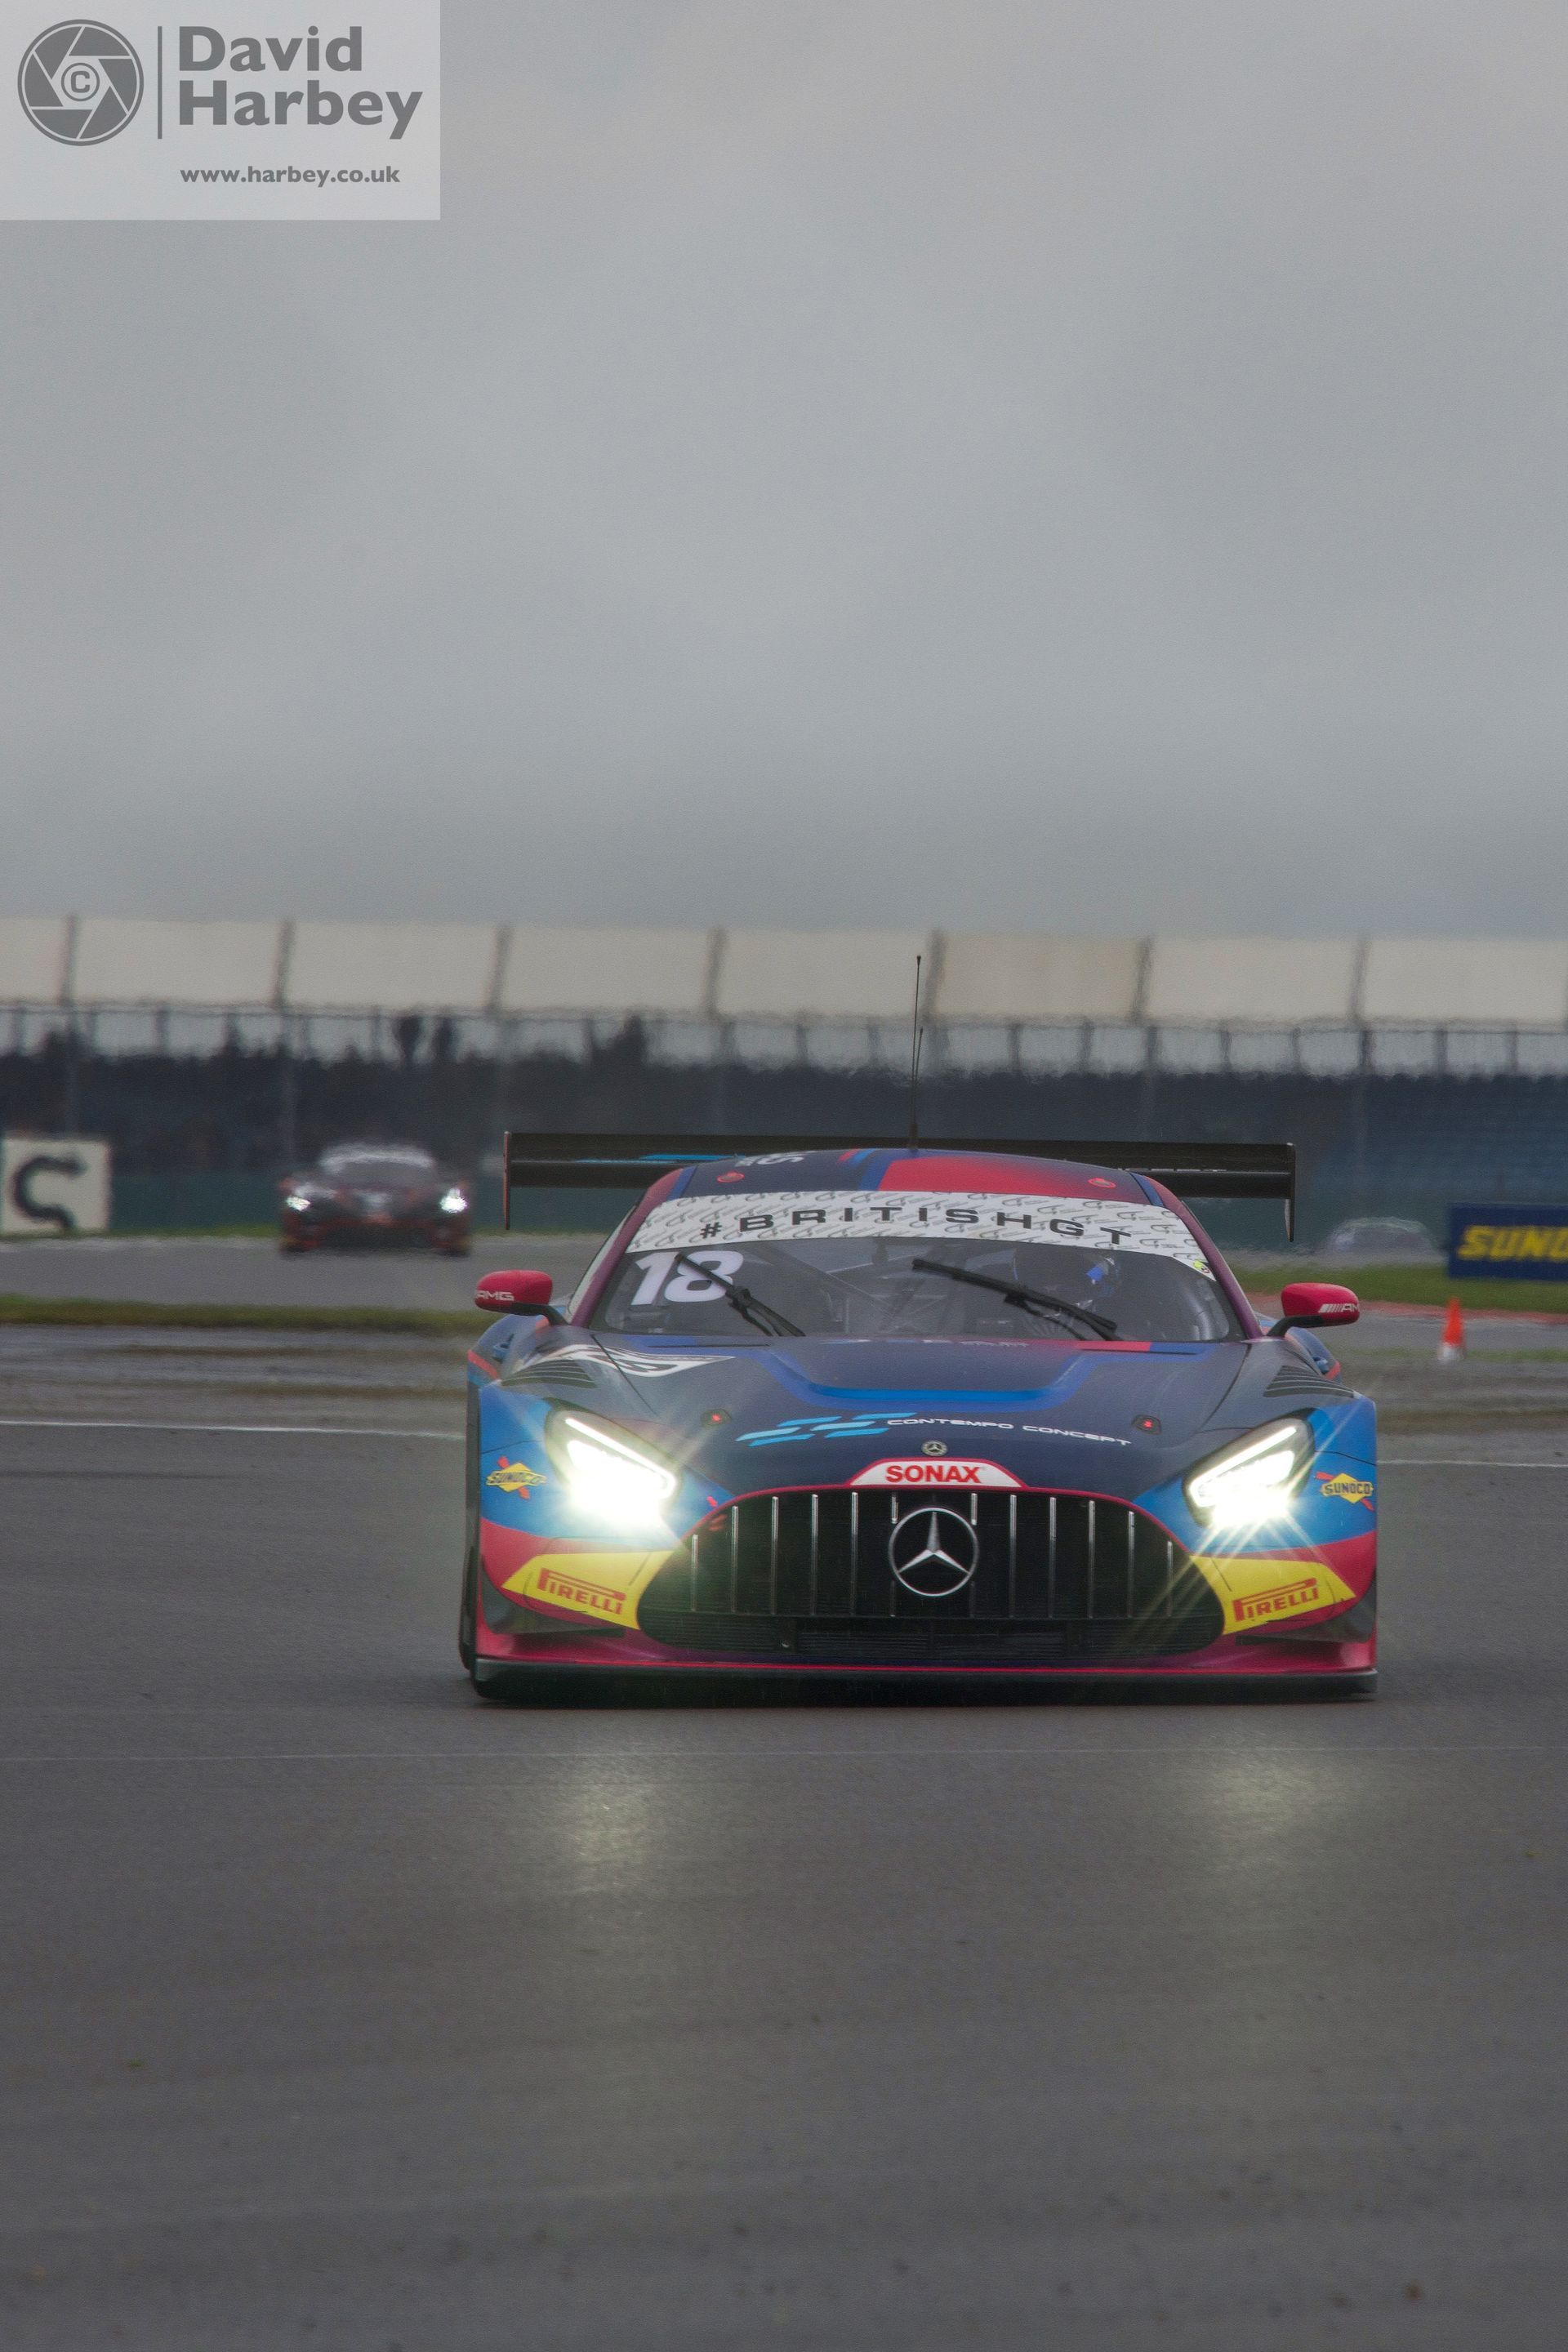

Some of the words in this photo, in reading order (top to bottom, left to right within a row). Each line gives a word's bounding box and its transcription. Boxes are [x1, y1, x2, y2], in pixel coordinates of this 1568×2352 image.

[700, 1206, 1132, 1246] #BRITISHGT
[630, 1250, 744, 1306] 18
[476, 1290, 514, 1302] AMG
[887, 1419, 1014, 1430] CONTEMPO
[1022, 1424, 1132, 1446] CONCEPT
[884, 1464, 982, 1484] SONAX
[1323, 1482, 1371, 1495] SUNOCO
[537, 1567, 626, 1615] PIRELLI
[1232, 1577, 1318, 1622] PIRELLI
